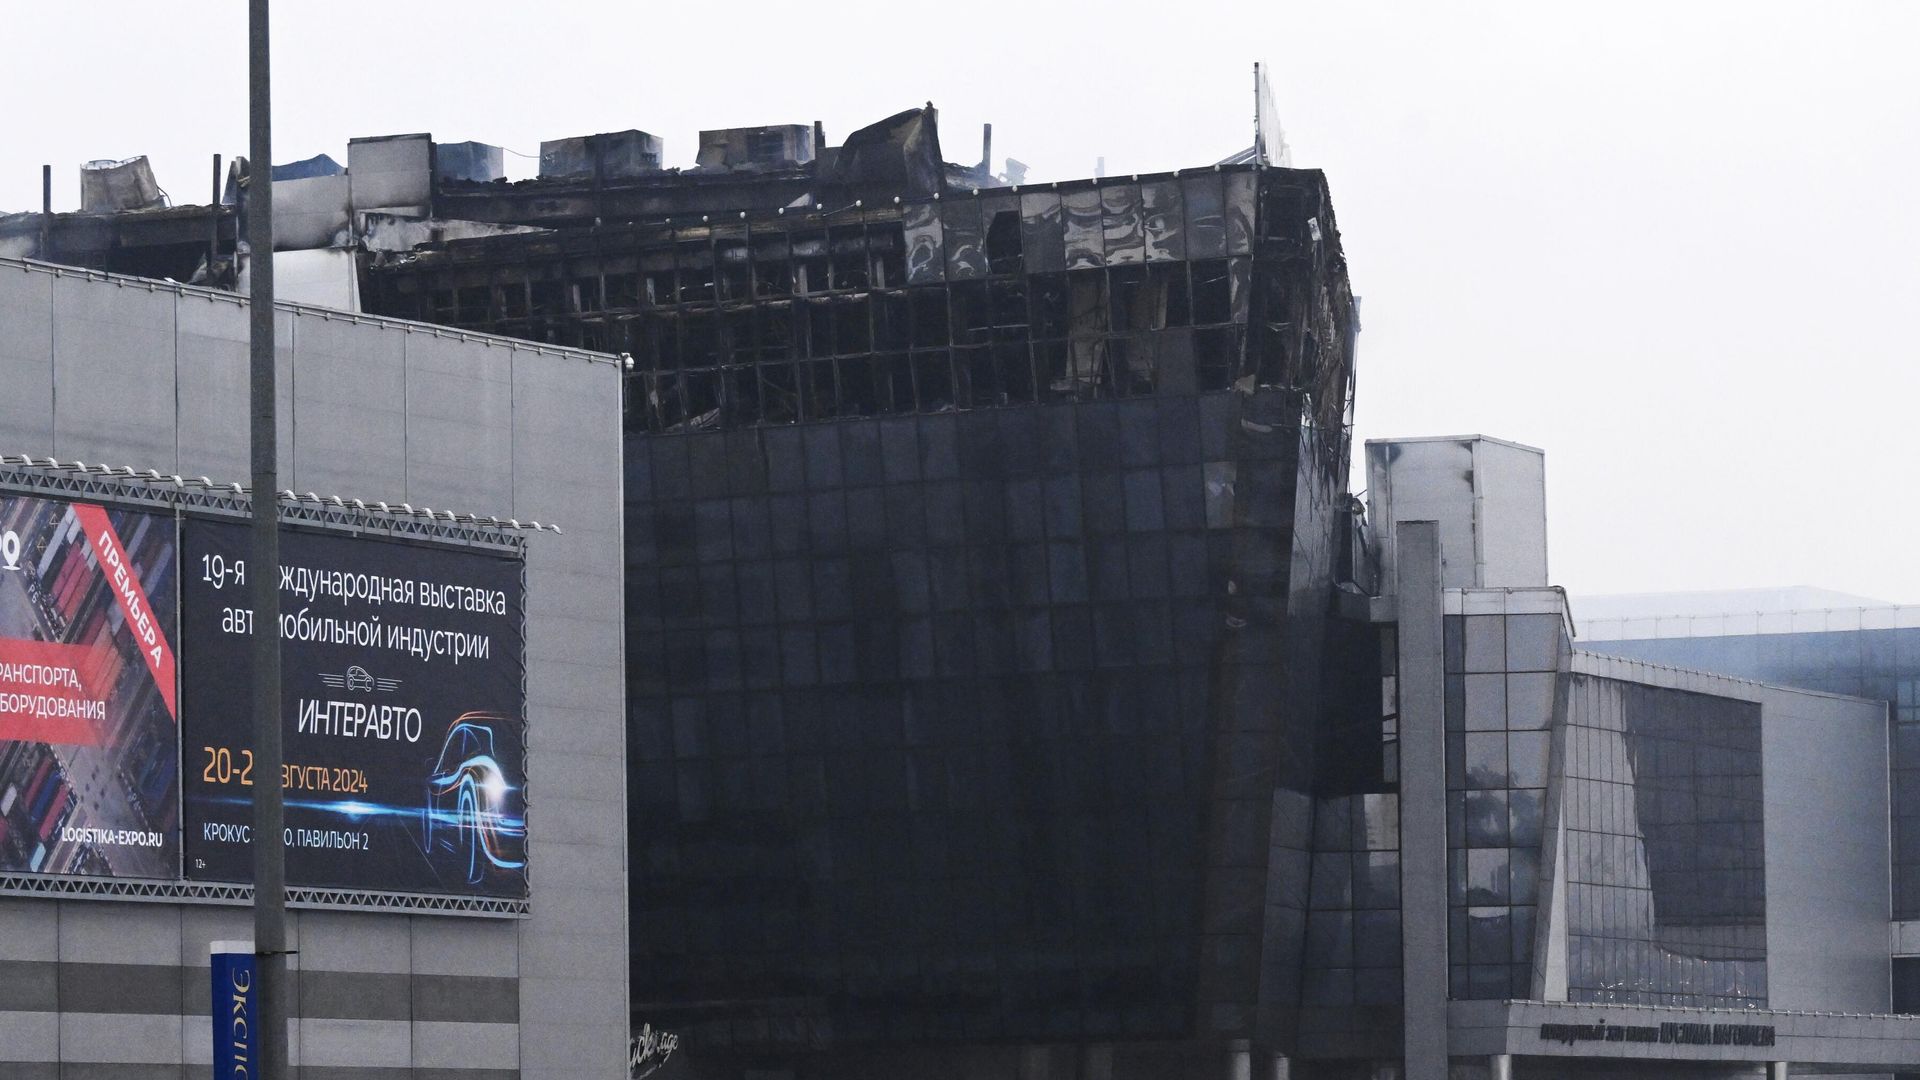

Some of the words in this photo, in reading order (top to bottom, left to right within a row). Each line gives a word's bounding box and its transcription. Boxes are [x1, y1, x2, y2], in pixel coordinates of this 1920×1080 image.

[98, 530, 163, 669] ПРЕМЬЕРА
[202, 554, 245, 590] 19-я
[278, 564, 414, 606] ждународная
[420, 580, 506, 616] выставка
[222, 606, 382, 649] автобильной
[387, 624, 490, 665] индустрии
[298, 698, 422, 743] ИНТЕРАВТО
[203, 746, 254, 786] 20-2
[281, 764, 331, 791] ВГУСТА
[332, 767, 368, 793] 2024
[61, 826, 163, 847] LOGISTIKA-EXPO.RU
[203, 822, 250, 844] КРОКУС
[297, 829, 360, 850] ПАВИЛЬОН
[362, 832, 369, 850] 2
[195, 858, 206, 869] 12+
